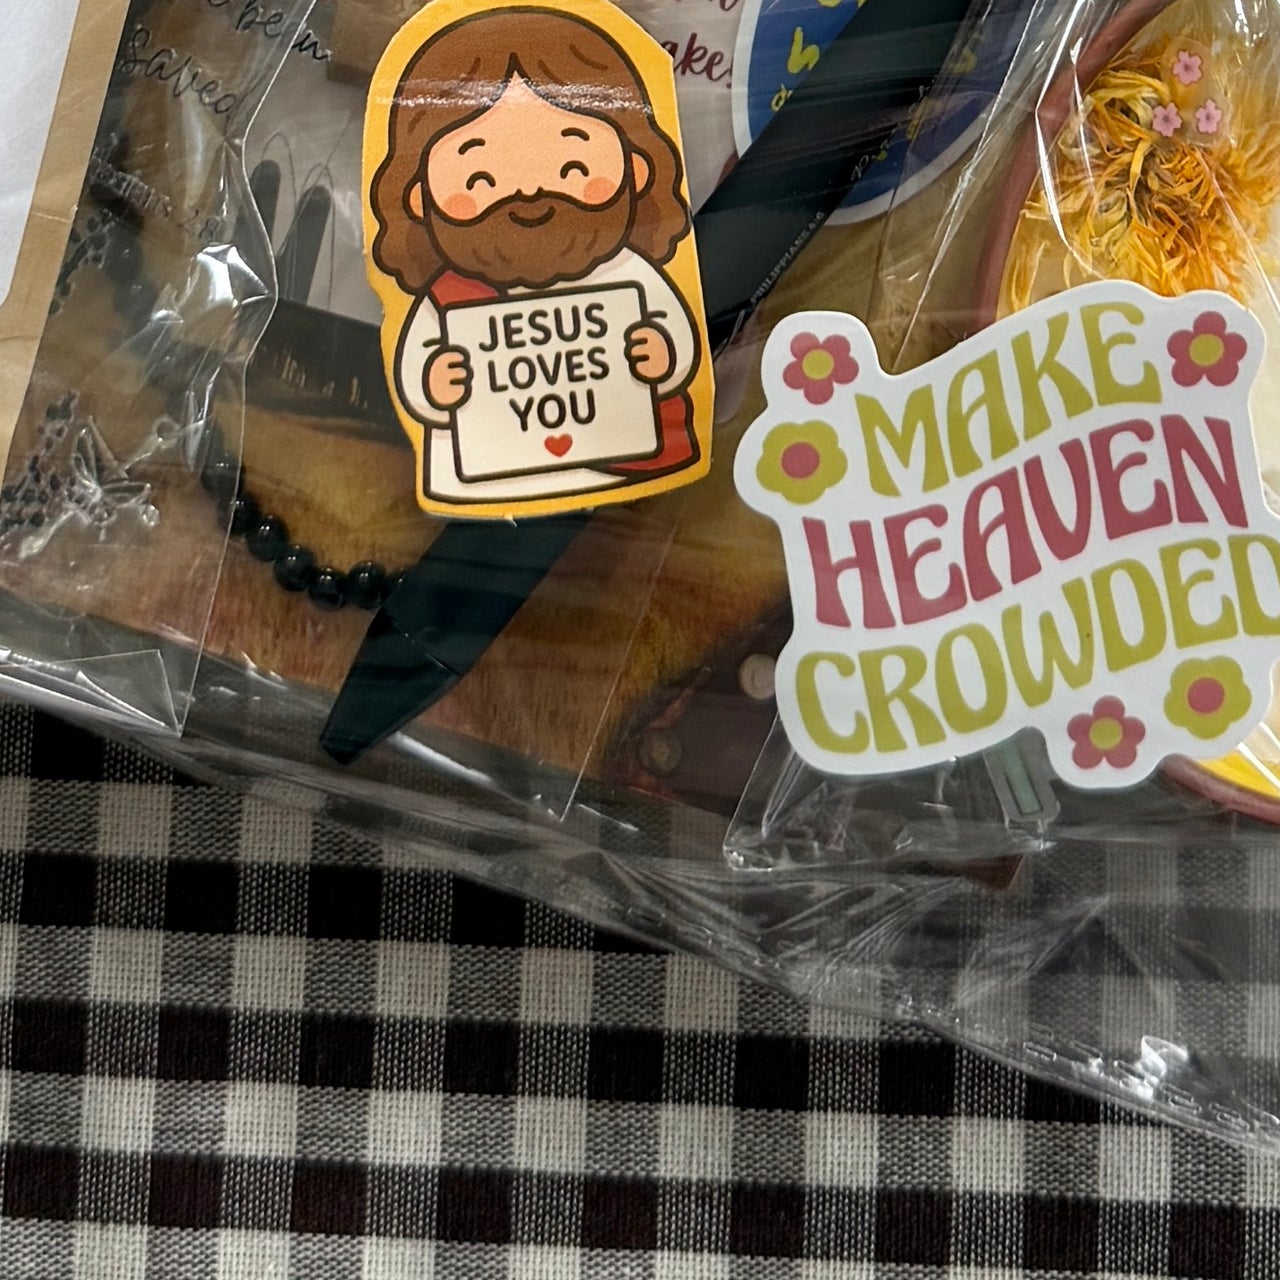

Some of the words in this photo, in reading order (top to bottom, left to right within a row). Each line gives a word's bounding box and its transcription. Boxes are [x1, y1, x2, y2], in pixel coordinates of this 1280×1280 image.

[478, 302, 609, 352] JESUS
[487, 347, 610, 393] LOVES
[509, 388, 598, 433] YOU
[854, 301, 1163, 498] MAKE
[802, 413, 1249, 631] HEAVEN
